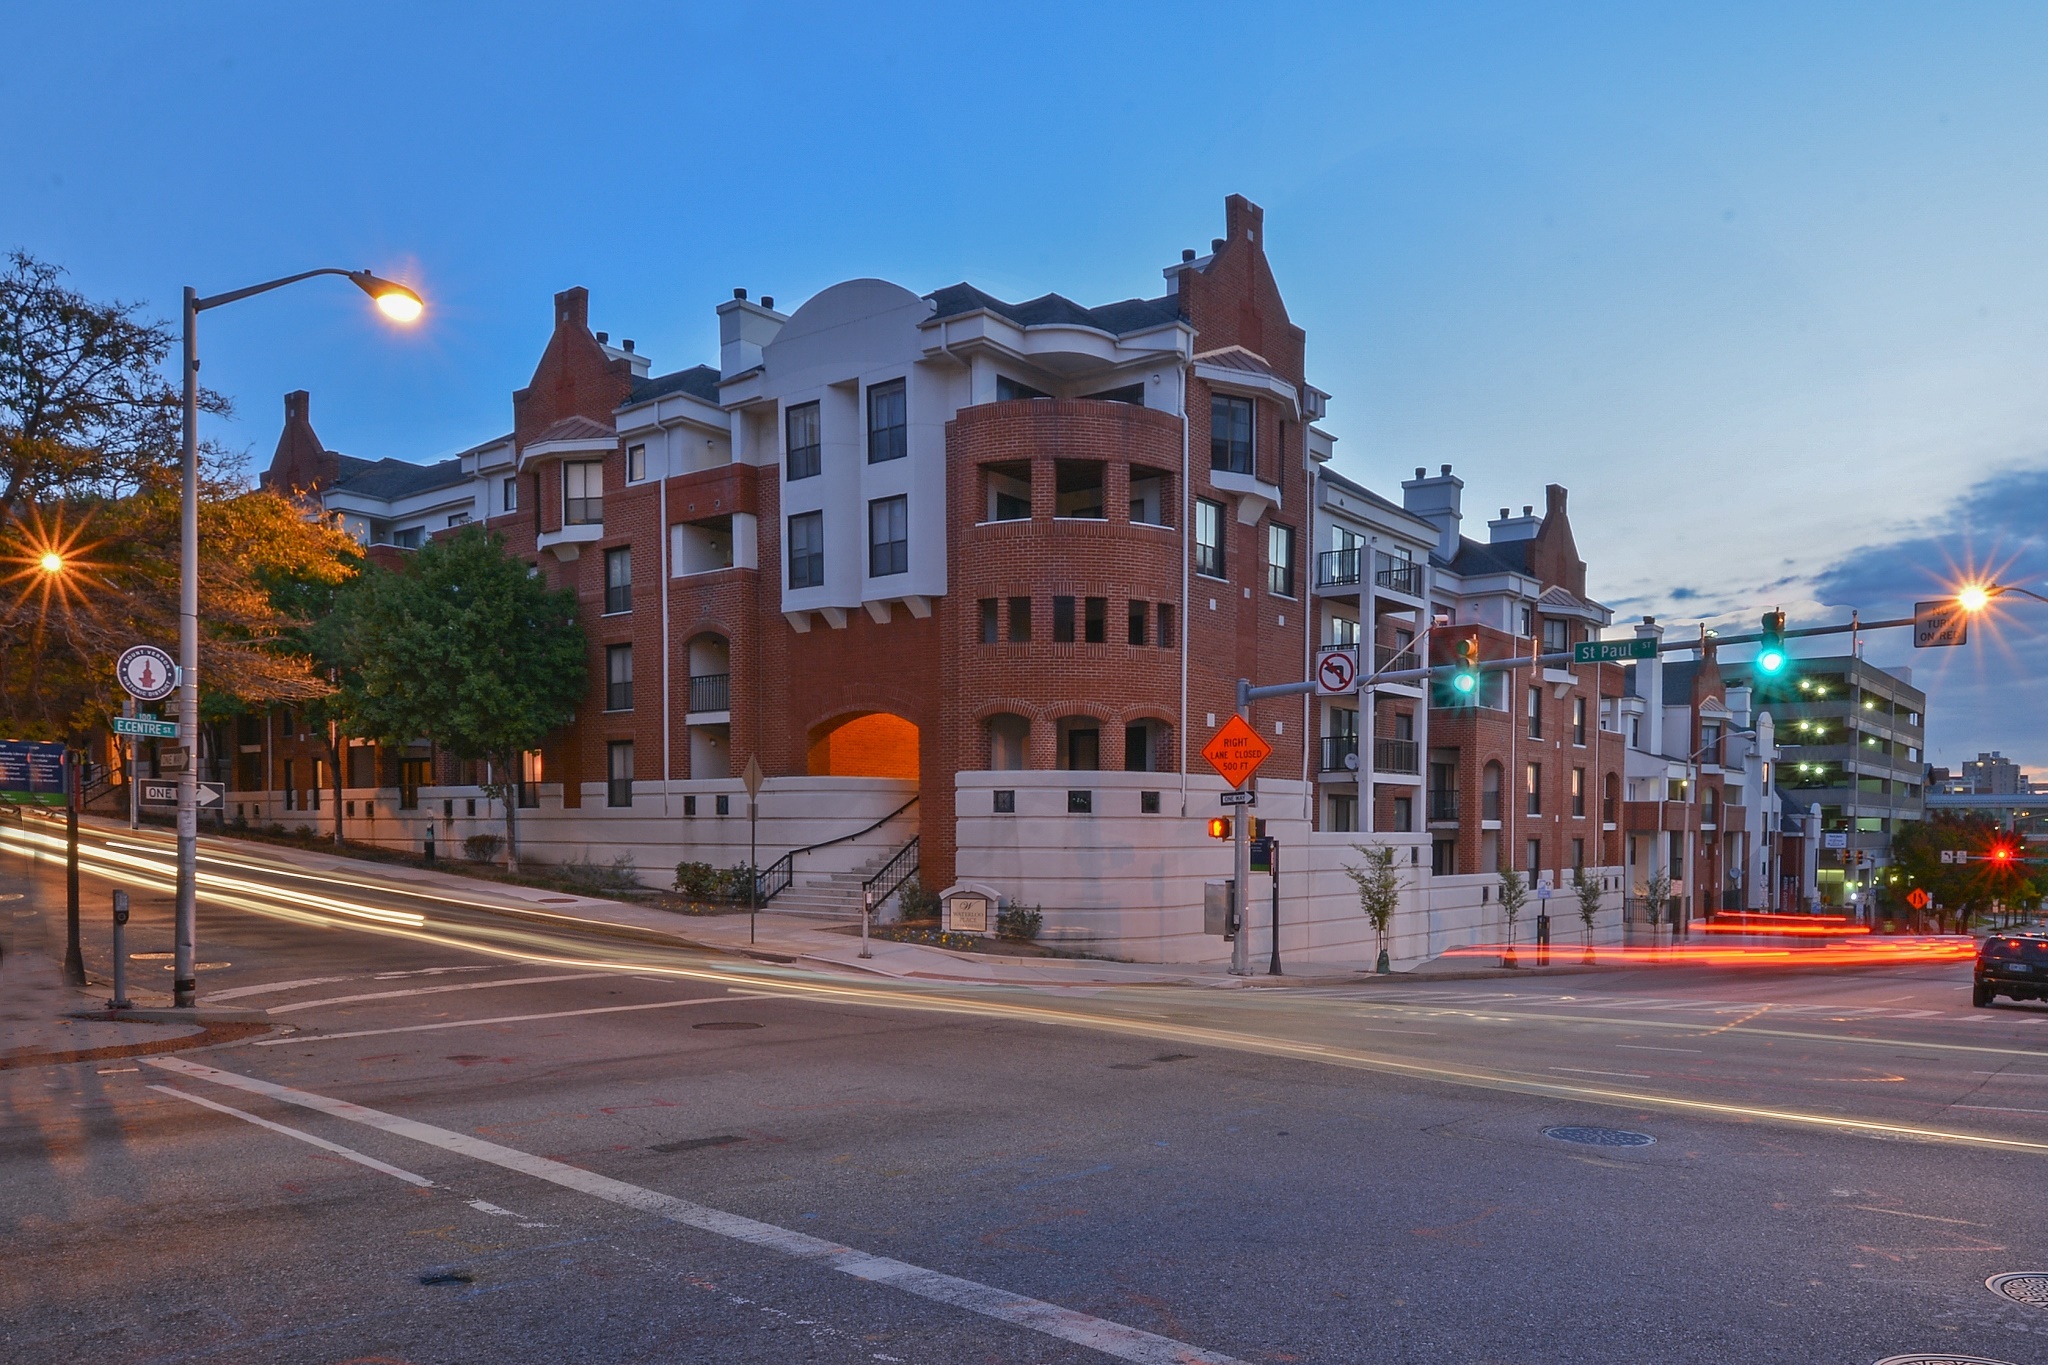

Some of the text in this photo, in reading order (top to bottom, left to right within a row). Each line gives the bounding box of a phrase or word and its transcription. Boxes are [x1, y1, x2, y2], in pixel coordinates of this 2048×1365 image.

[1932, 607, 1949, 616] NO
[1927, 618, 1955, 628] TURN
[1920, 632, 1935, 641] ON
[1582, 641, 1652, 659] St Paul ST
[123, 649, 170, 669] MOUNT VERNON
[123, 676, 171, 697] HISTORIC DISTRICT
[1223, 738, 1248, 747] RIGHT
[1210, 749, 1262, 759] LANE CLOSED
[1223, 762, 1249, 770] 500 FT
[149, 787, 172, 798] ONE
